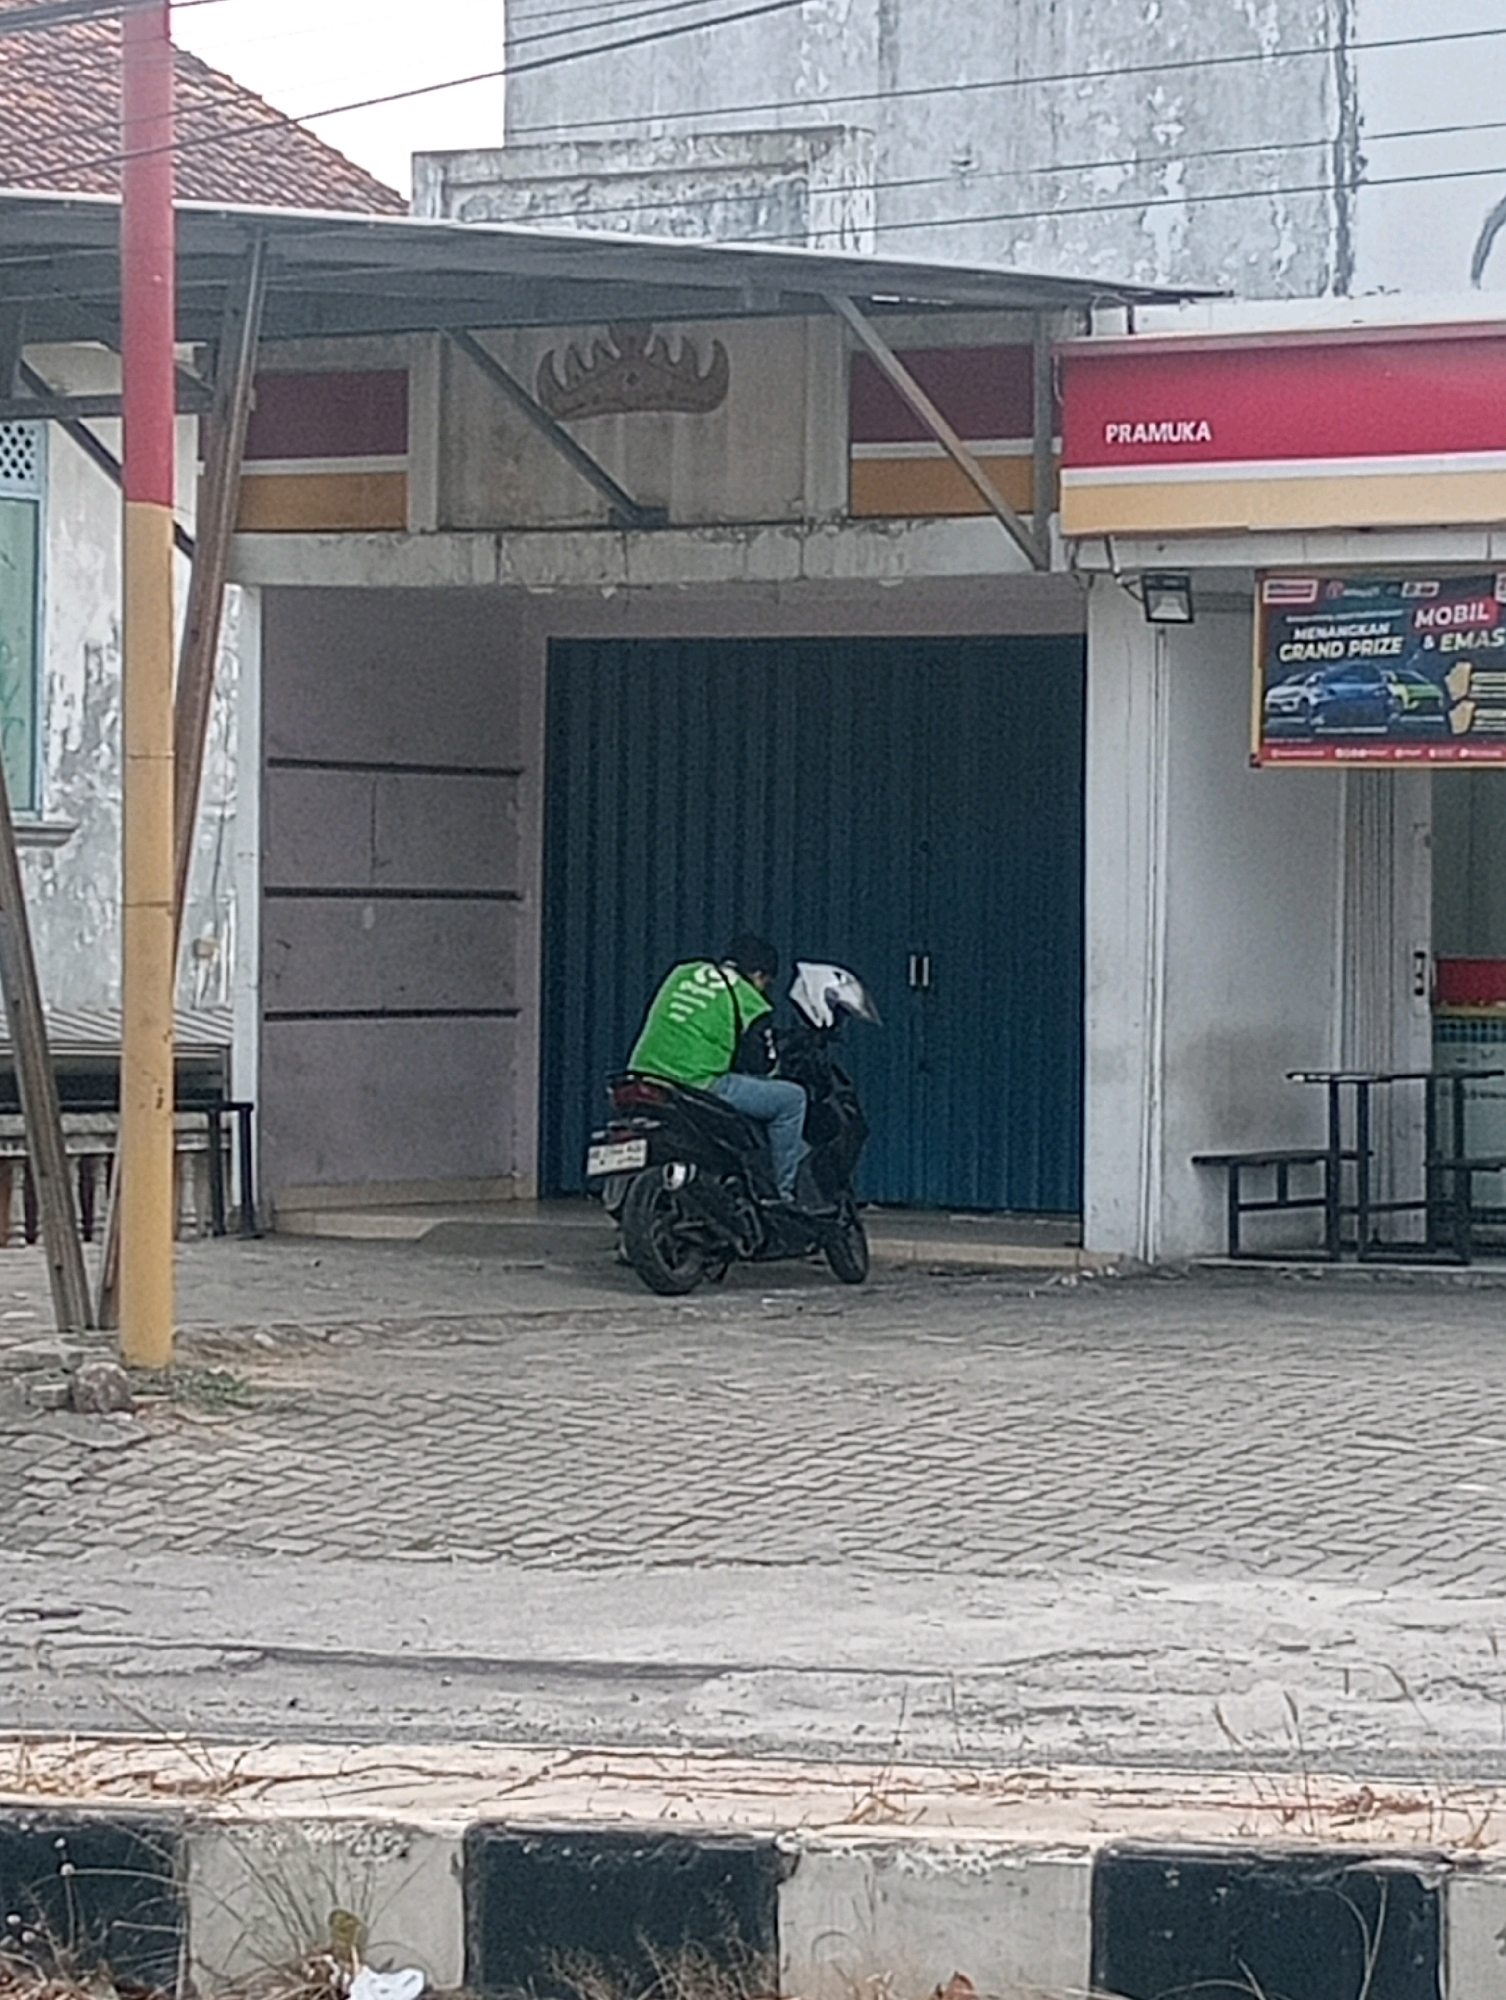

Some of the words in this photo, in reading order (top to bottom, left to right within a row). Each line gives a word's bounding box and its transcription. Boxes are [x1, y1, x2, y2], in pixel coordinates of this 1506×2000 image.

[1105, 420, 1211, 443] PRAMUKA
[1414, 602, 1490, 629] MOBIL
[1293, 622, 1391, 641] MENANGKAN
[1439, 627, 1506, 652] EMAS
[1279, 641, 1345, 662] GRAND
[1348, 636, 1404, 656] PRIZE
